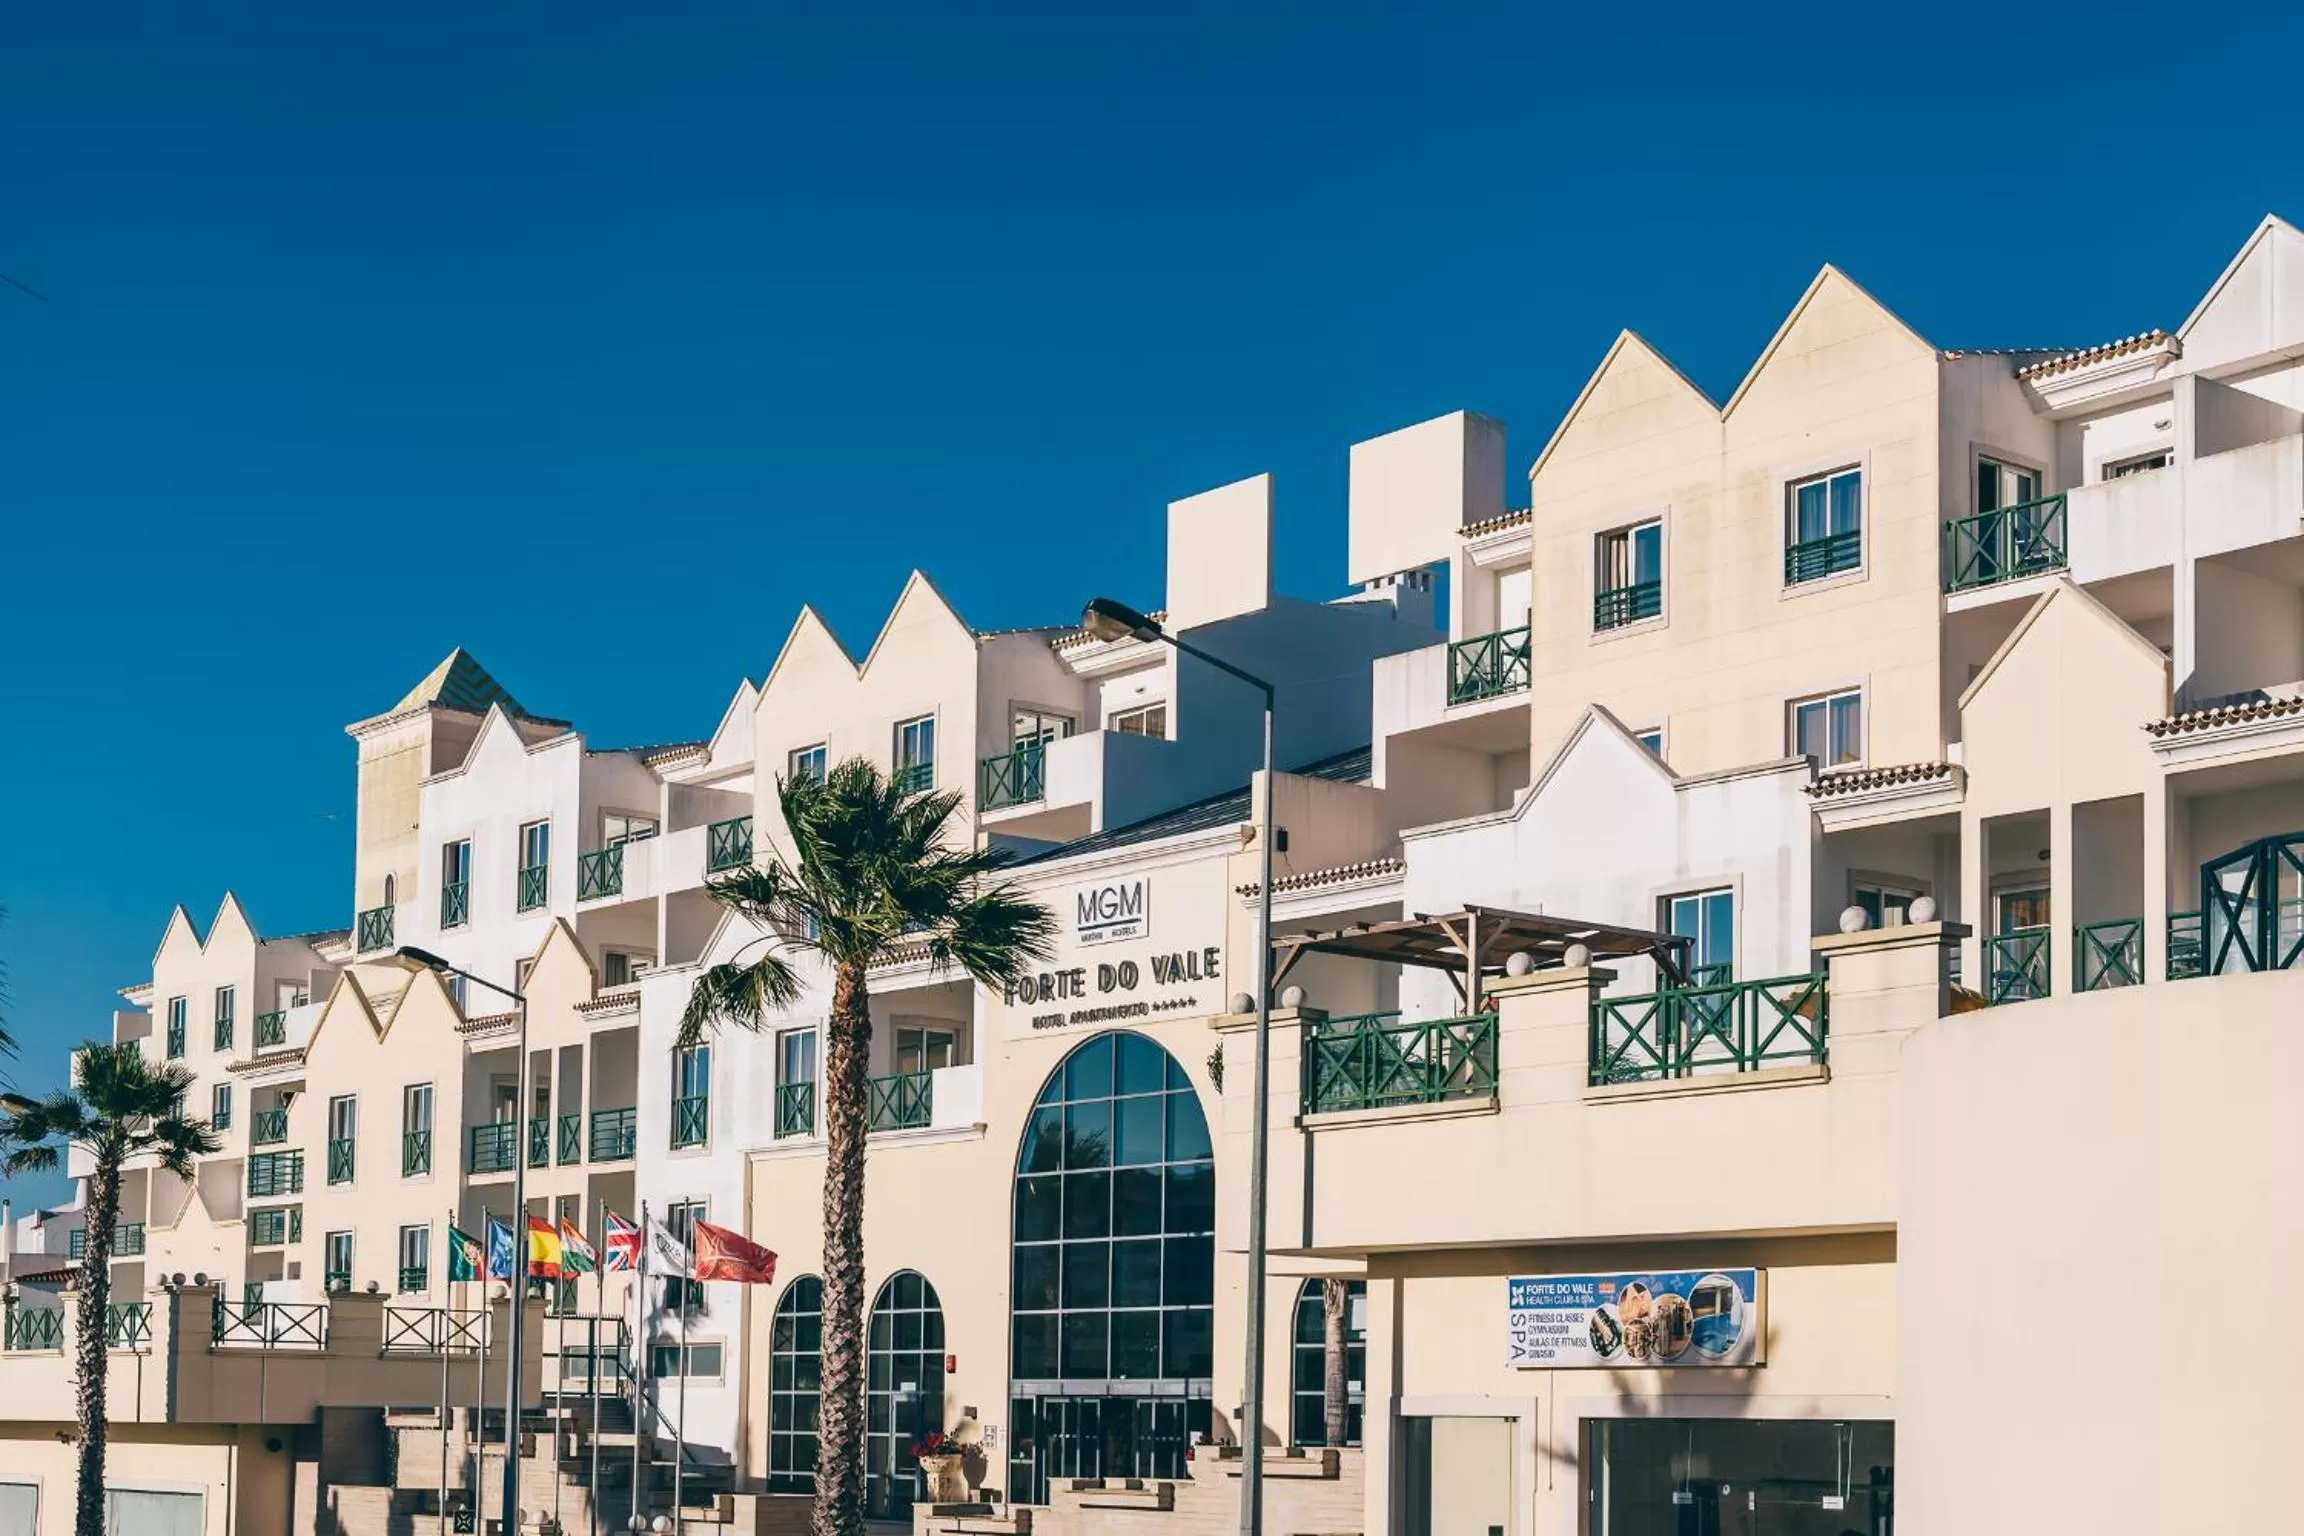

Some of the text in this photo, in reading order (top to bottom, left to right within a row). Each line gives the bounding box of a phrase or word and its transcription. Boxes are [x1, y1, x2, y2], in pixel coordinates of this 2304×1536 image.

[1078, 882, 1142, 925] MGM
[1004, 947, 1220, 1007] FORTE DO VALE
[1032, 1013, 1067, 1030] HOTEL
[1526, 1284, 1555, 1295] FORTE
[1557, 1283, 1571, 1294] DO
[1572, 1283, 1594, 1294] VALE
[1526, 1296, 1553, 1305] HEALTH
[1554, 1295, 1573, 1304] CLUB
[1528, 1313, 1584, 1323] FITNESS CLASSES
[1528, 1325, 1569, 1334] GYMNASIUM
[1511, 1313, 1526, 1359] SPA
[1529, 1337, 1587, 1347] AULAS DE FITNESS
